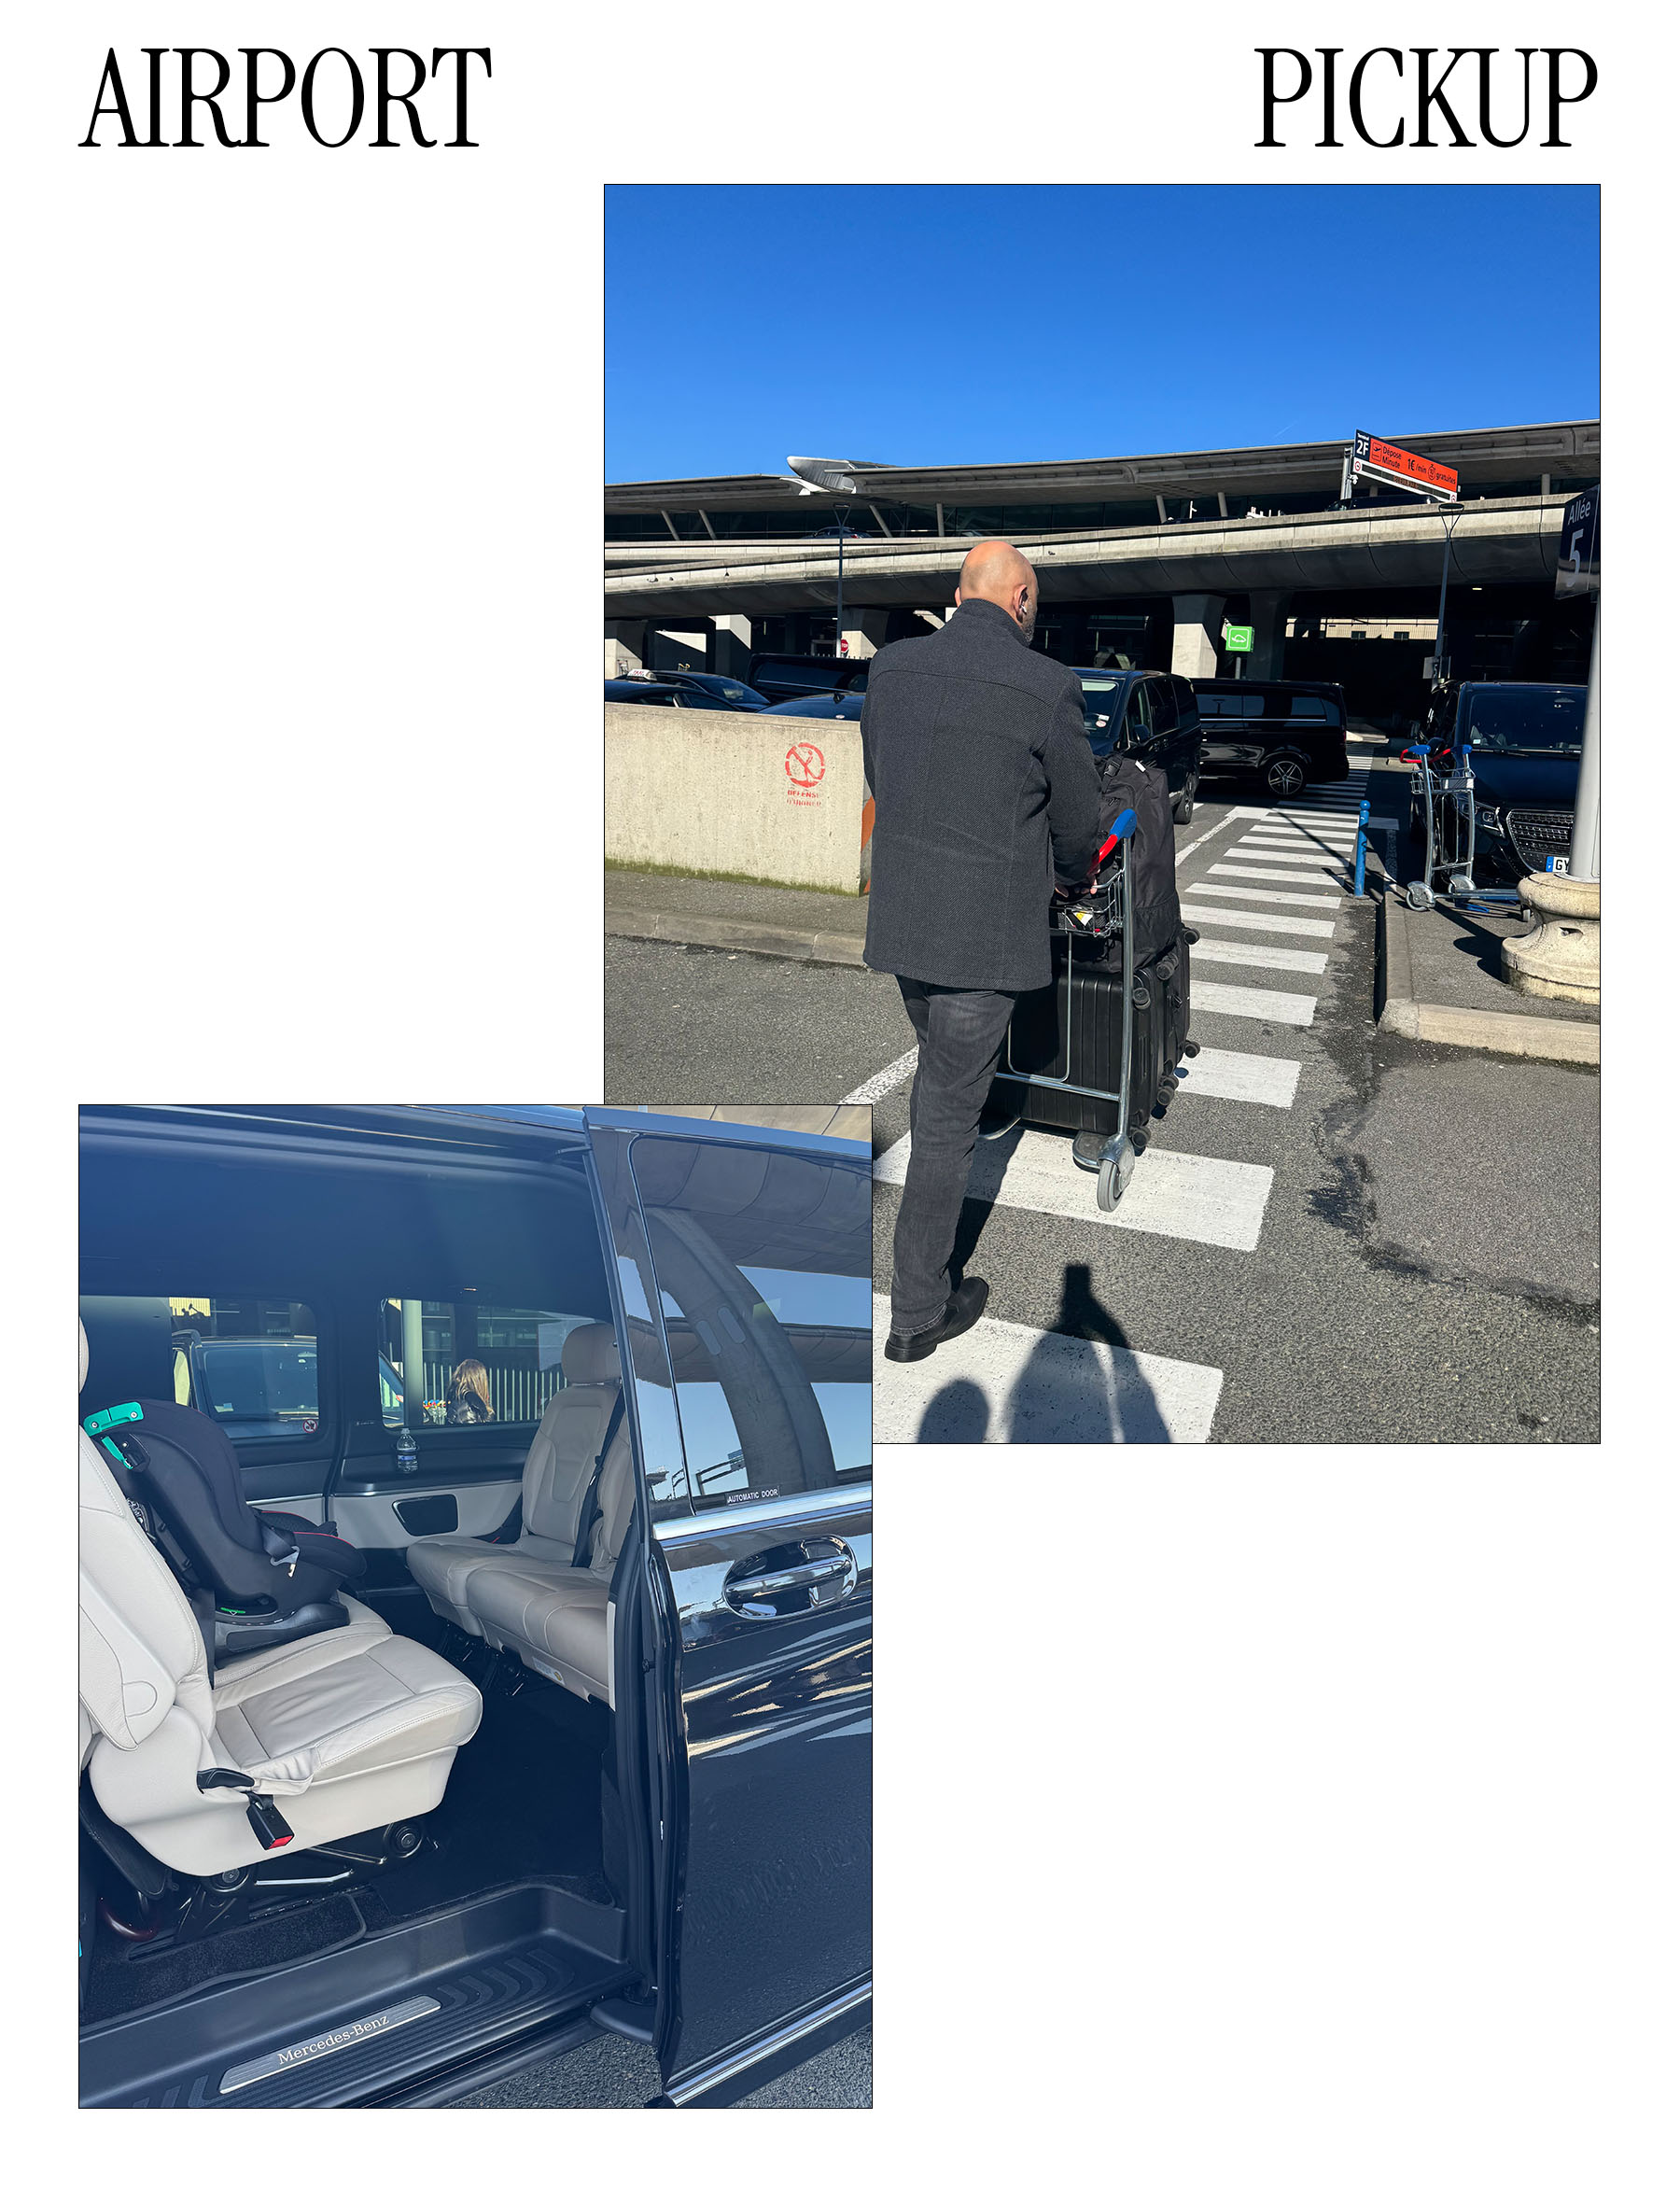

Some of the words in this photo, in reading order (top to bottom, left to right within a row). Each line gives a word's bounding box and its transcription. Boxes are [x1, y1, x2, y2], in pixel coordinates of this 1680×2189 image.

[1356, 440, 1369, 456] 2F
[1382, 456, 1400, 469] Minute
[1568, 498, 1591, 525] Allée
[1566, 528, 1584, 588] 5
[727, 1492, 760, 1503] AUTOMATIC
[762, 1489, 778, 1498] DOOR
[277, 2015, 389, 2064] Mercedes-Benz
